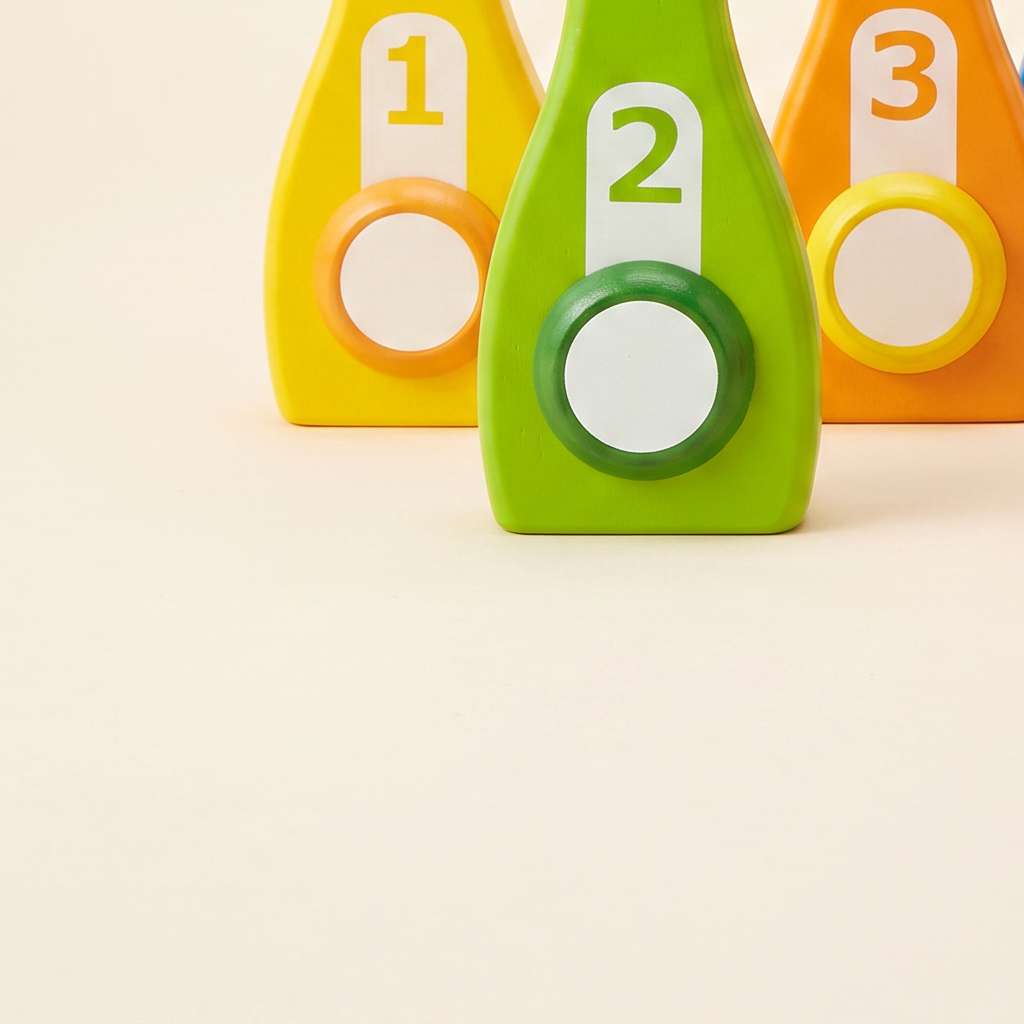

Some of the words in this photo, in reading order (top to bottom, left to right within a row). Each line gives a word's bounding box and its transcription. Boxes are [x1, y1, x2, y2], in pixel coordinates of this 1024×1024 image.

[388, 35, 444, 126] 1
[872, 31, 938, 121] 3
[609, 107, 681, 203] 2
